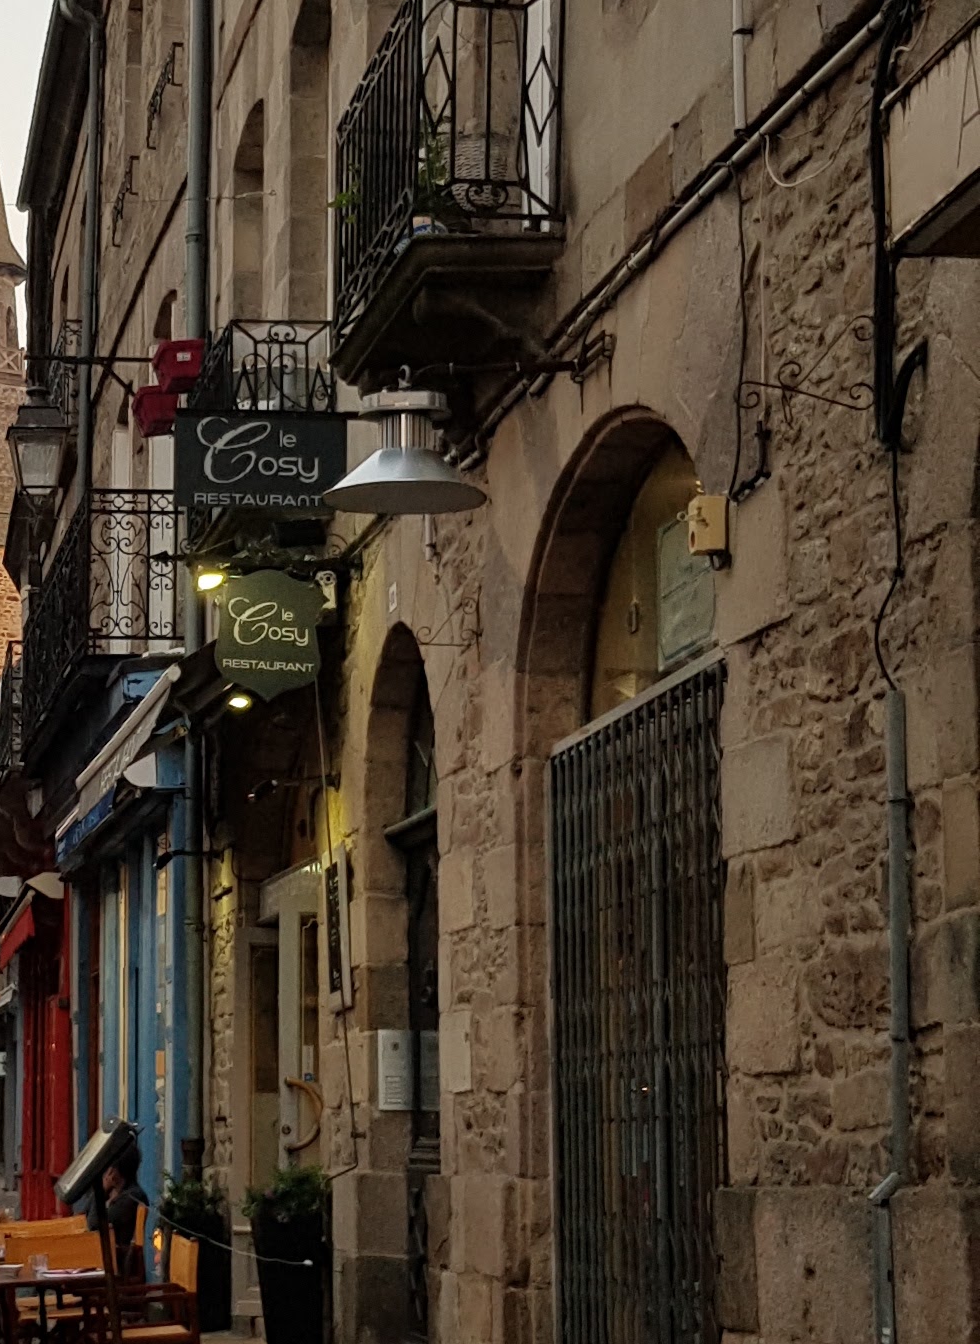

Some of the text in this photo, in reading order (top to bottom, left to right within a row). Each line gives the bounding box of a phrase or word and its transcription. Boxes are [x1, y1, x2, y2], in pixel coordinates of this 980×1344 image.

[279, 429, 297, 448] le
[196, 416, 320, 483] Cosy
[193, 492, 322, 507] RESTAURANT
[227, 597, 310, 646] Cosy
[281, 608, 294, 622] le
[222, 658, 315, 673] RESTAURANT
